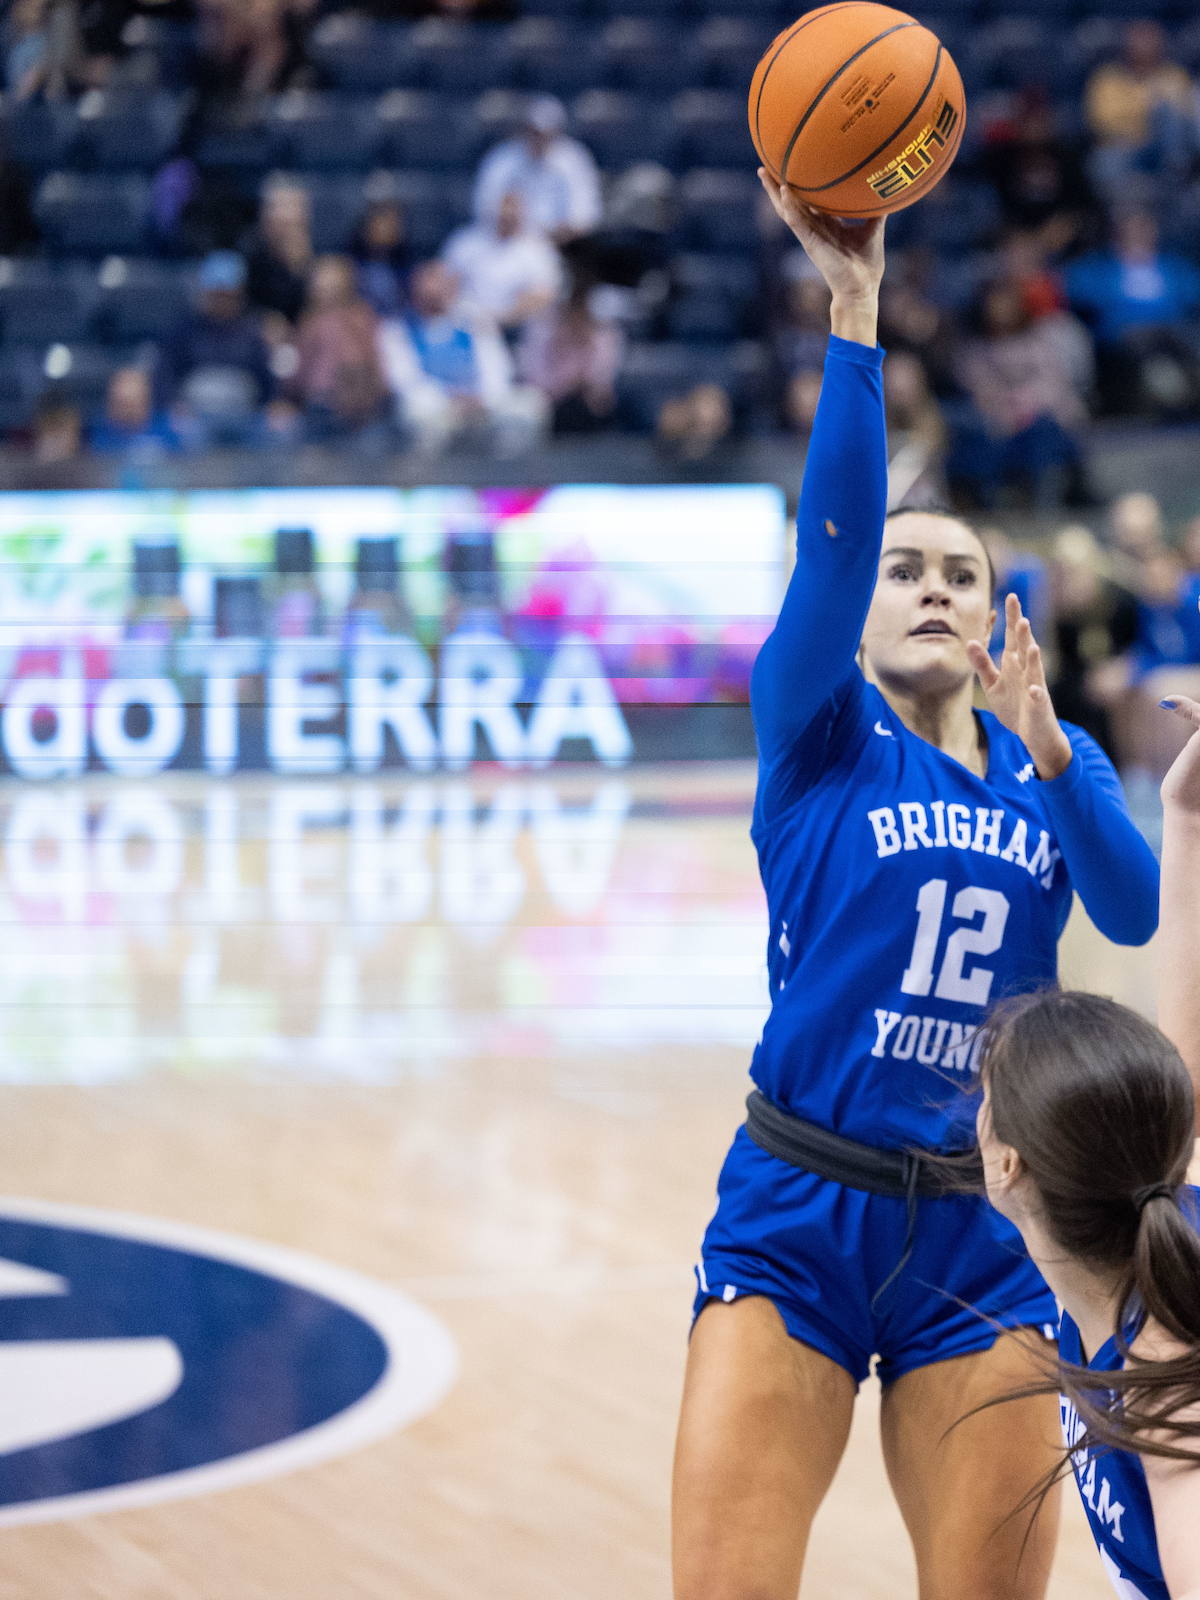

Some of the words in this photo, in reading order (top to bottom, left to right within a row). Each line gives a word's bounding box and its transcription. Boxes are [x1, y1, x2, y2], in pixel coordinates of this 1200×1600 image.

[866, 93, 943, 183] MPIONSHIP
[870, 99, 958, 200] ELITE
[2, 636, 633, 778] doTERRA
[868, 800, 1061, 891] BRIGHAM
[900, 878, 1010, 1006] 12
